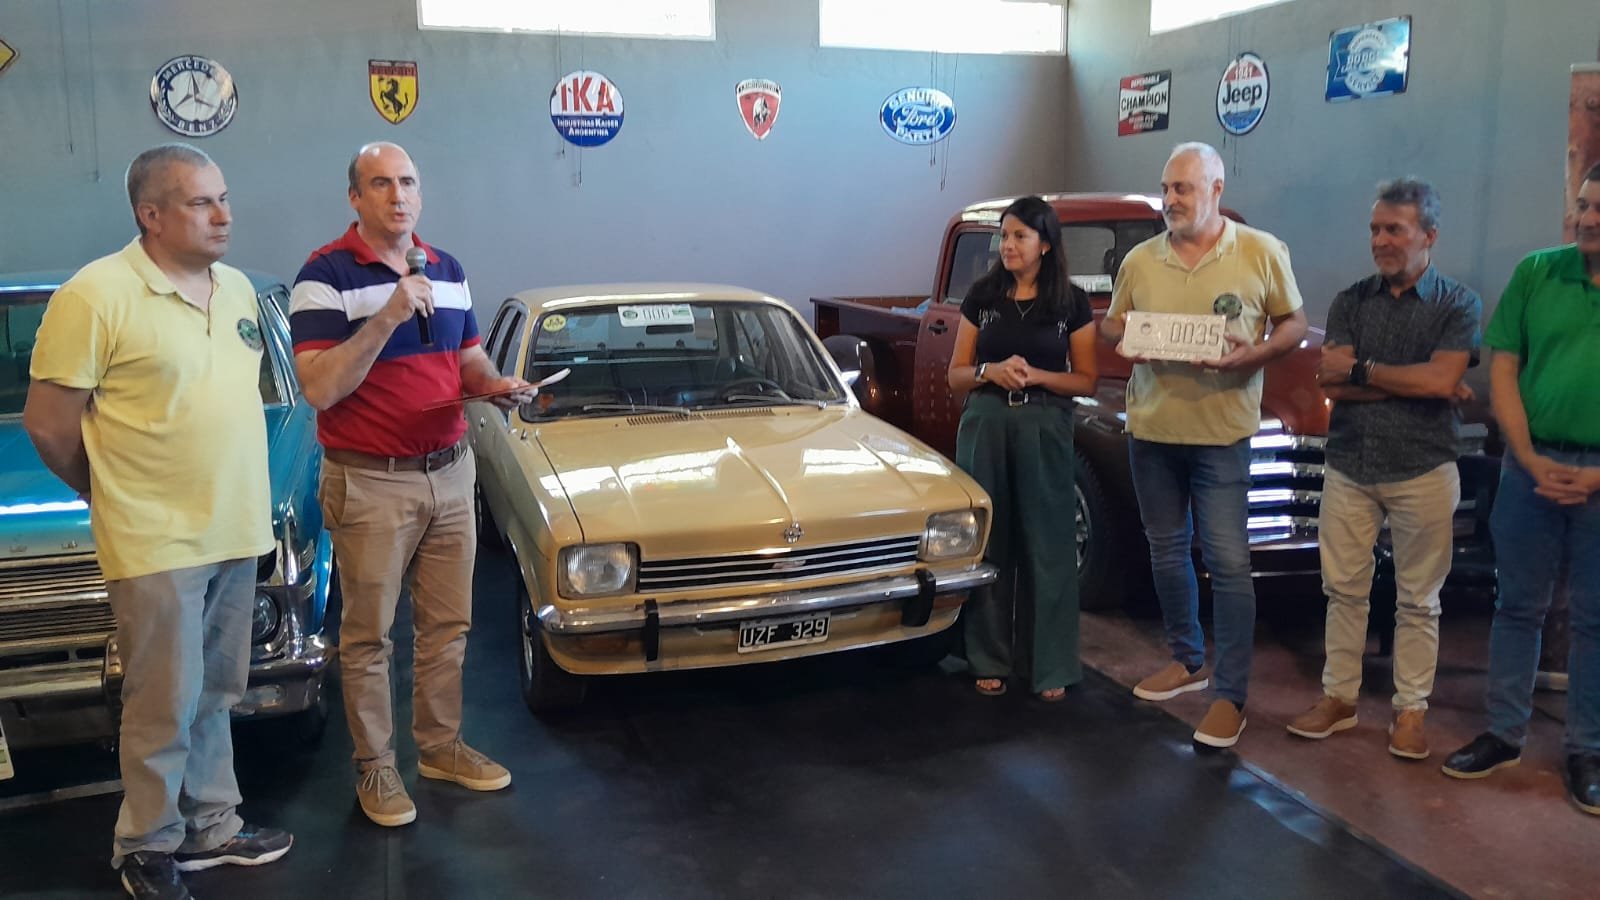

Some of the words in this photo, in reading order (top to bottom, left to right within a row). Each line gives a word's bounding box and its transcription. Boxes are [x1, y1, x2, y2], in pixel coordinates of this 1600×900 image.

[561, 76, 614, 112] IKA
[1120, 91, 1167, 112] CHAMPION
[1222, 83, 1263, 106] Jeep
[177, 119, 218, 133] BENZ
[898, 106, 940, 127] Ford
[895, 127, 940, 142] PARTS
[1169, 321, 1220, 346] 0035
[742, 625, 779, 647] UZF
[791, 617, 826, 640] 329
